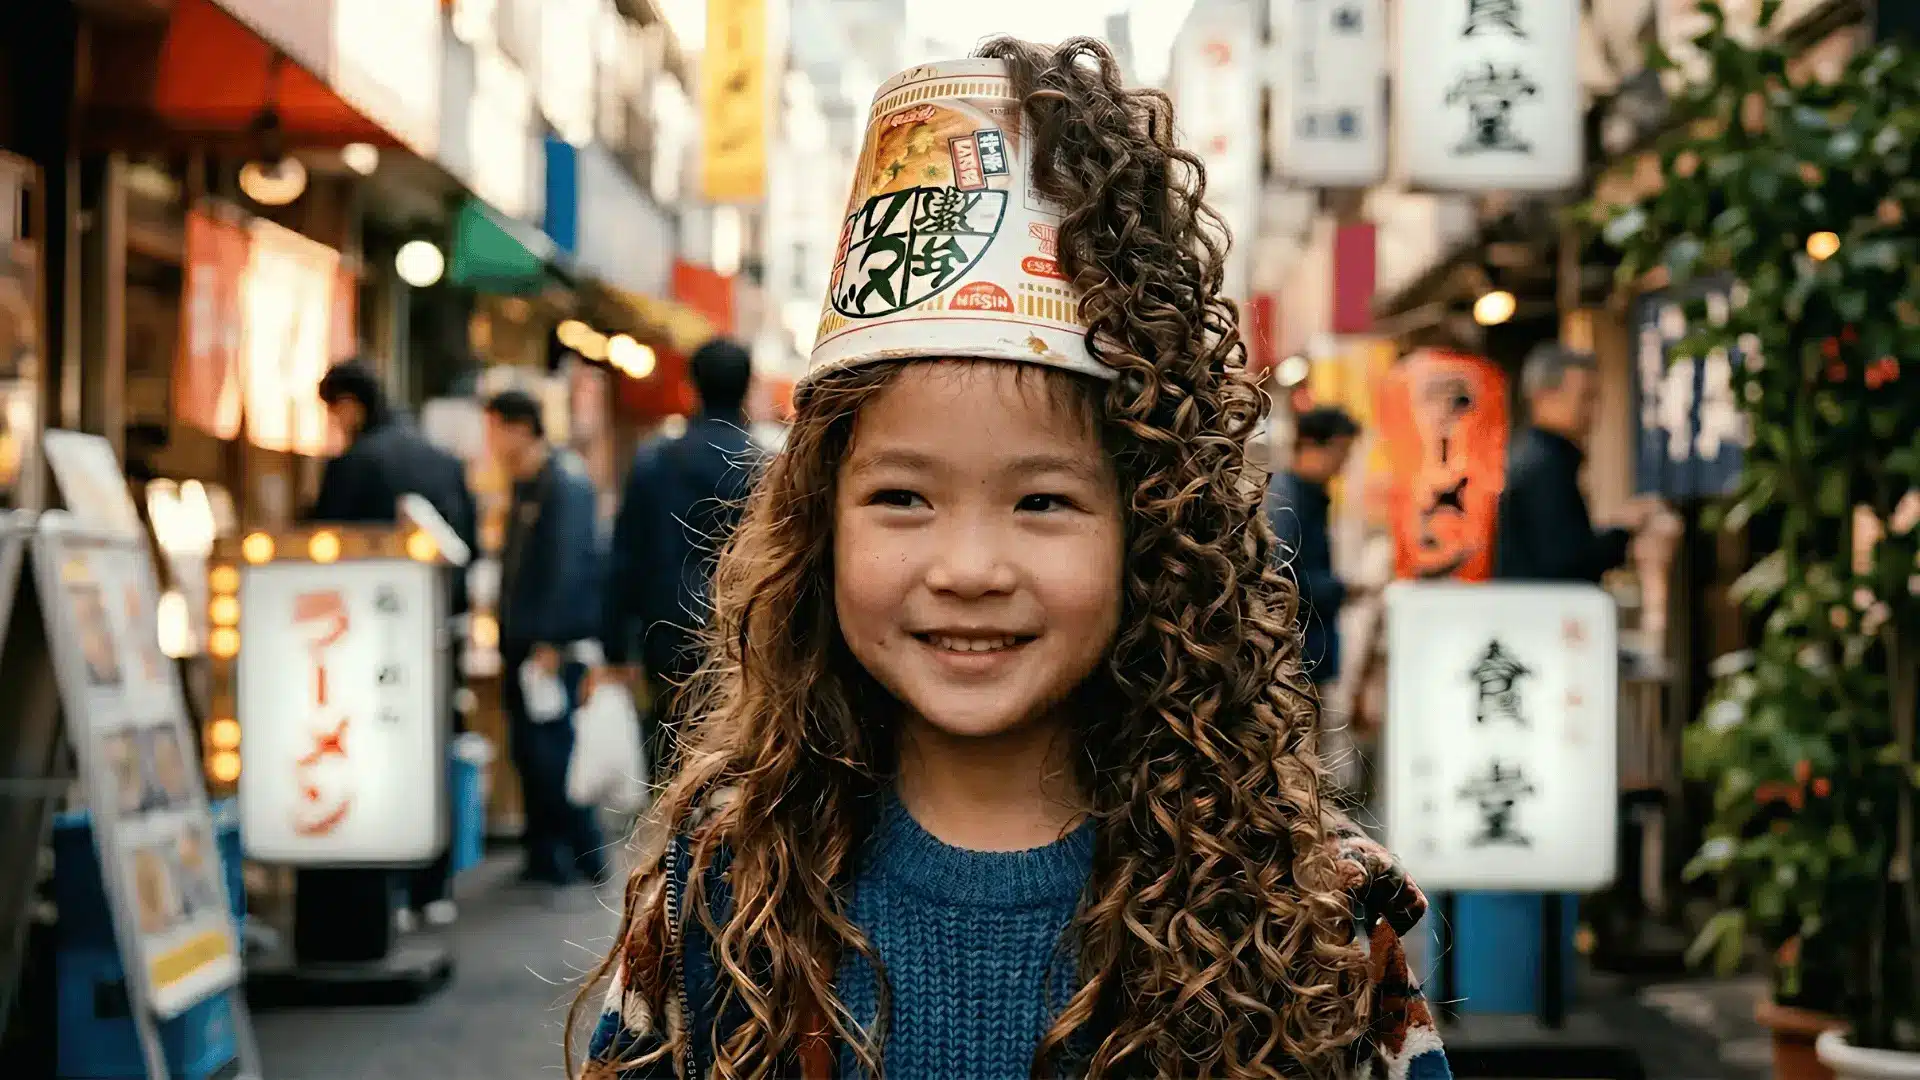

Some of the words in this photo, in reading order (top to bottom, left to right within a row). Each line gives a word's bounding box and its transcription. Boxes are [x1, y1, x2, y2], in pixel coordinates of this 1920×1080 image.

[292, 588, 351, 837] ラーメン
[1456, 636, 1538, 847] 食堂
